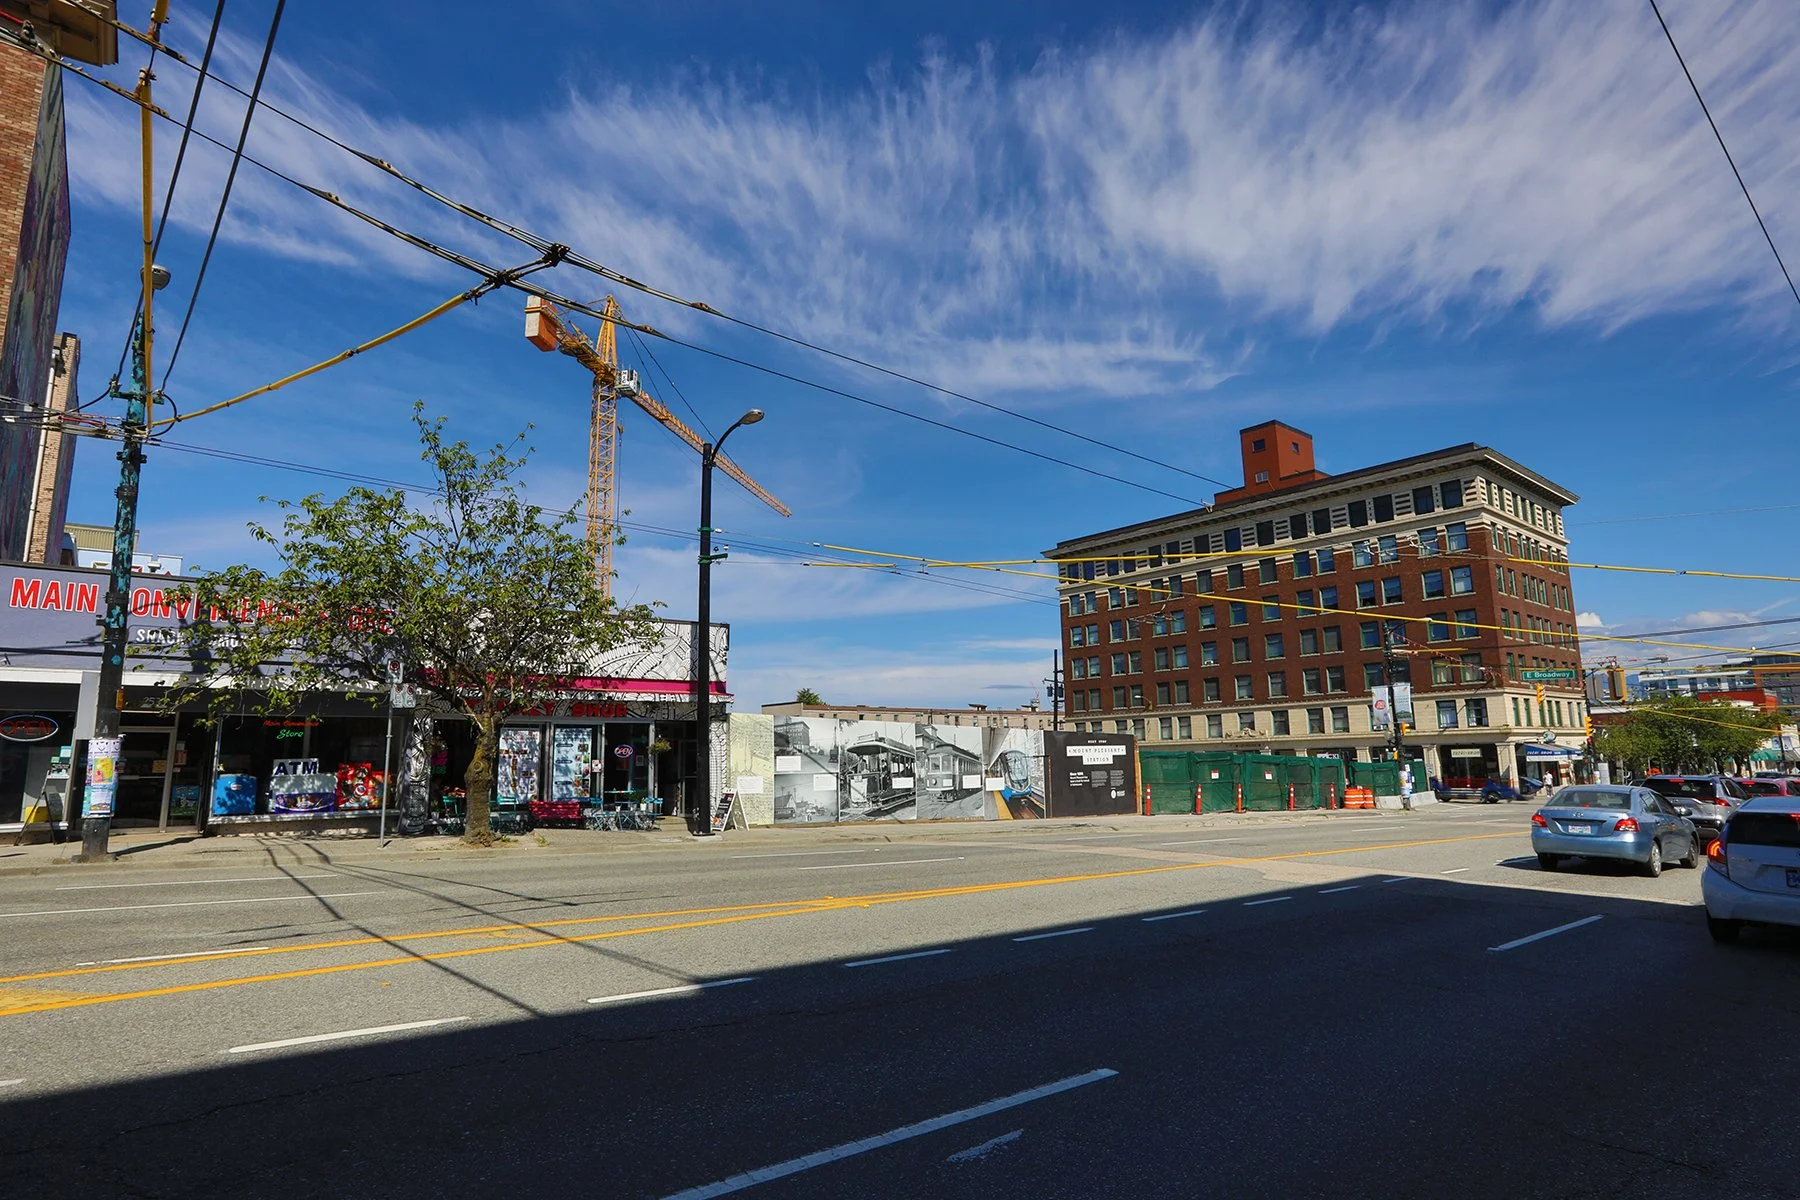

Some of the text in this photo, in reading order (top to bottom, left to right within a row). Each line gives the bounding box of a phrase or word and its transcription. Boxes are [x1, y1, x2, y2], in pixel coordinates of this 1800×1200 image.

[9, 577, 100, 614] MAIN
[1534, 671, 1570, 679] Broadway
[571, 702, 628, 718] SHOP
[0, 719, 55, 736] OPEN
[276, 728, 305, 740] Store
[274, 759, 318, 776] ATM
